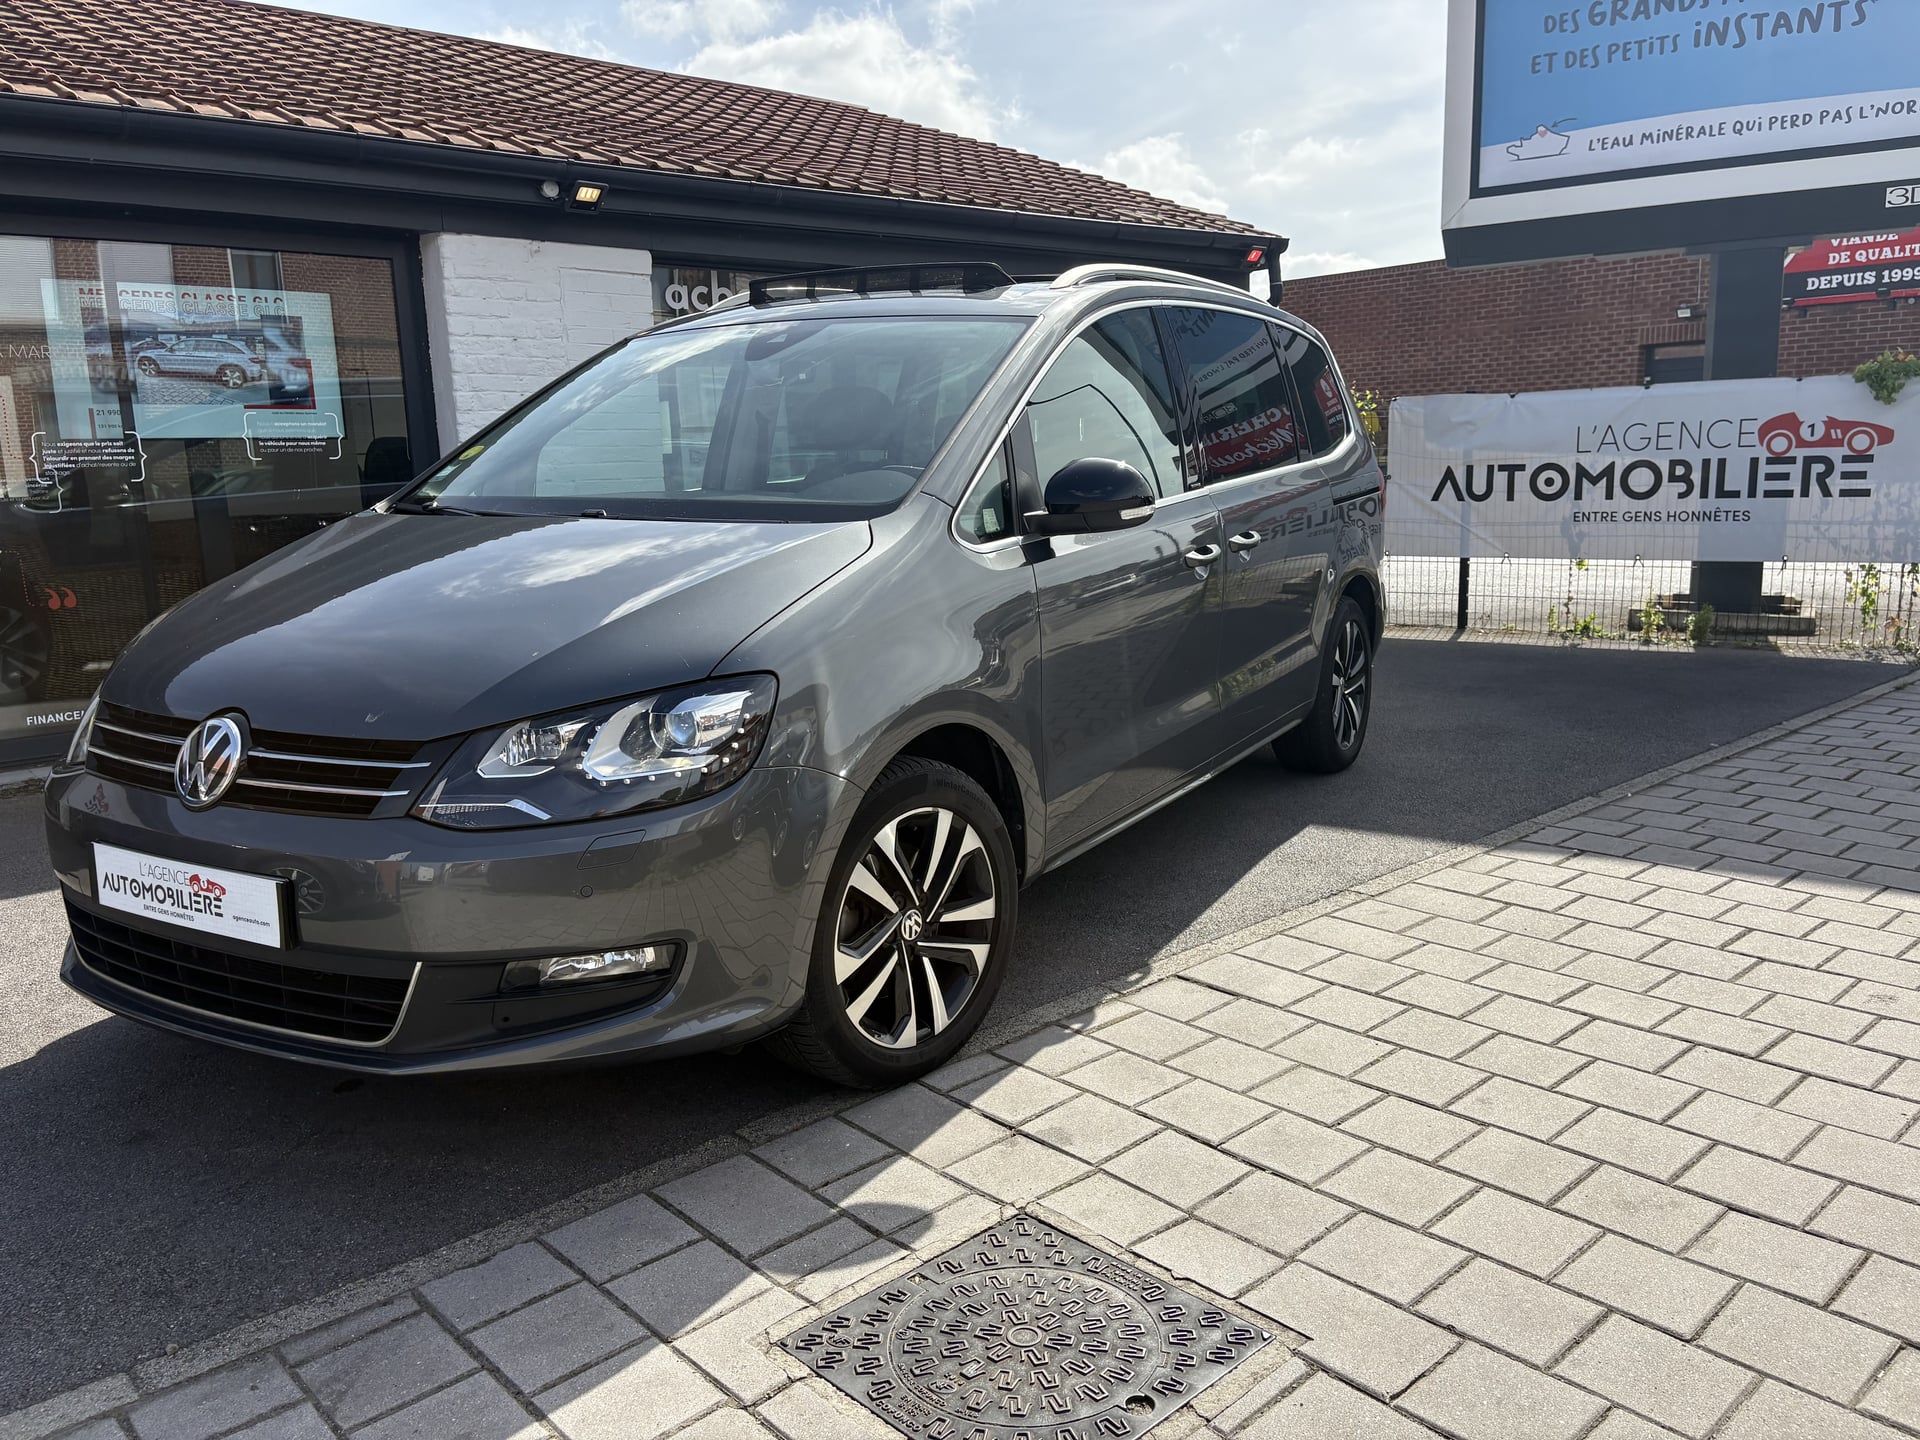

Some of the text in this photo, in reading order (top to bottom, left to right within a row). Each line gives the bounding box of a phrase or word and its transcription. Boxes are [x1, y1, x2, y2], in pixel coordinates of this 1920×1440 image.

[1543, 9, 1580, 33] DES
[1531, 52, 1558, 74] ET
[1564, 44, 1600, 69] DES
[1588, 134, 1634, 151] L'EAU
[1768, 113, 1813, 131] PERD
[1819, 106, 1853, 125] PAS
[1859, 99, 1920, 119] L'NOR
[1828, 251, 1850, 265] DE
[1806, 267, 1920, 291] DEPUIS 1999
[57, 441, 83, 449] exigeons
[1576, 417, 1758, 454] L'AGENCE
[1573, 507, 1751, 523] ENTRE GENS HONNÊTES
[26, 710, 85, 727] FINANCE
[139, 860, 190, 887] L'AGENCE
[143, 904, 195, 922] ENTRE GENS HONNÊTES
[232, 914, 271, 927] agenceauto.com
[875, 1400, 922, 1432] COFUNCO
